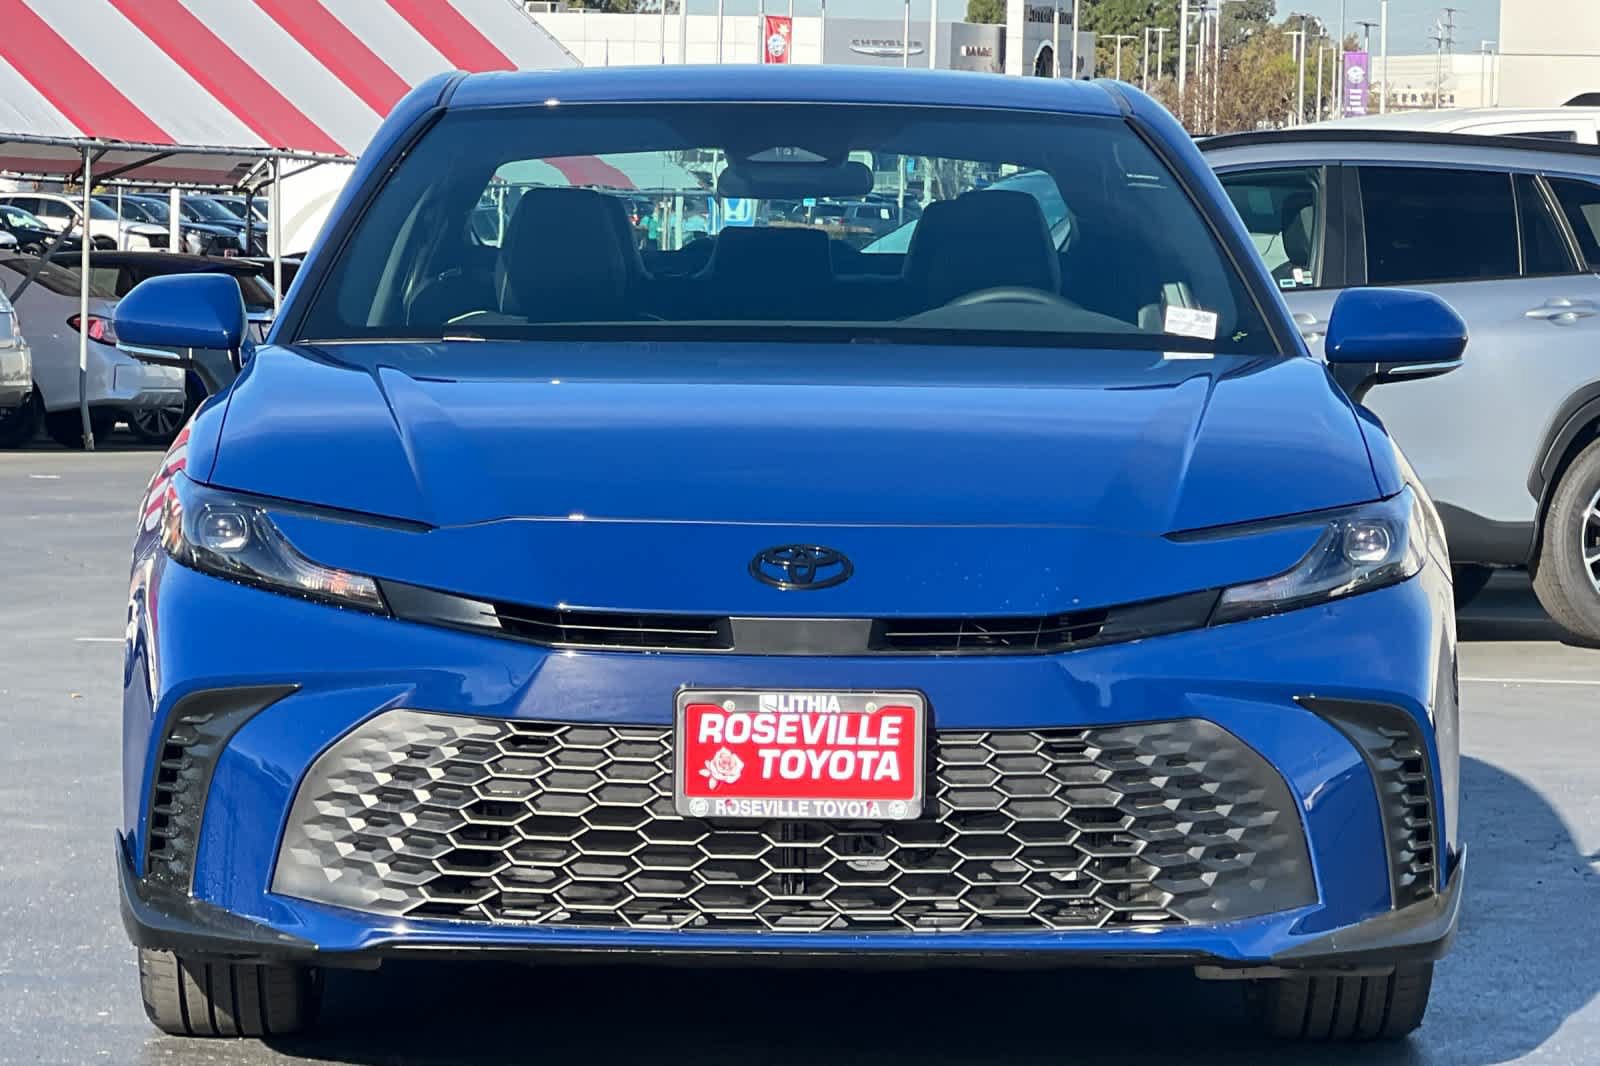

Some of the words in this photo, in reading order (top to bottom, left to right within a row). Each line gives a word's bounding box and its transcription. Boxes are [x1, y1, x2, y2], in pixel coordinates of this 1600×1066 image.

[778, 695, 841, 713] LITHIA
[698, 713, 903, 746] ROSEVILLE
[758, 749, 901, 781] TOYOTA
[715, 799, 809, 816] ROSEVILLE
[814, 800, 881, 817] TOYOTA
